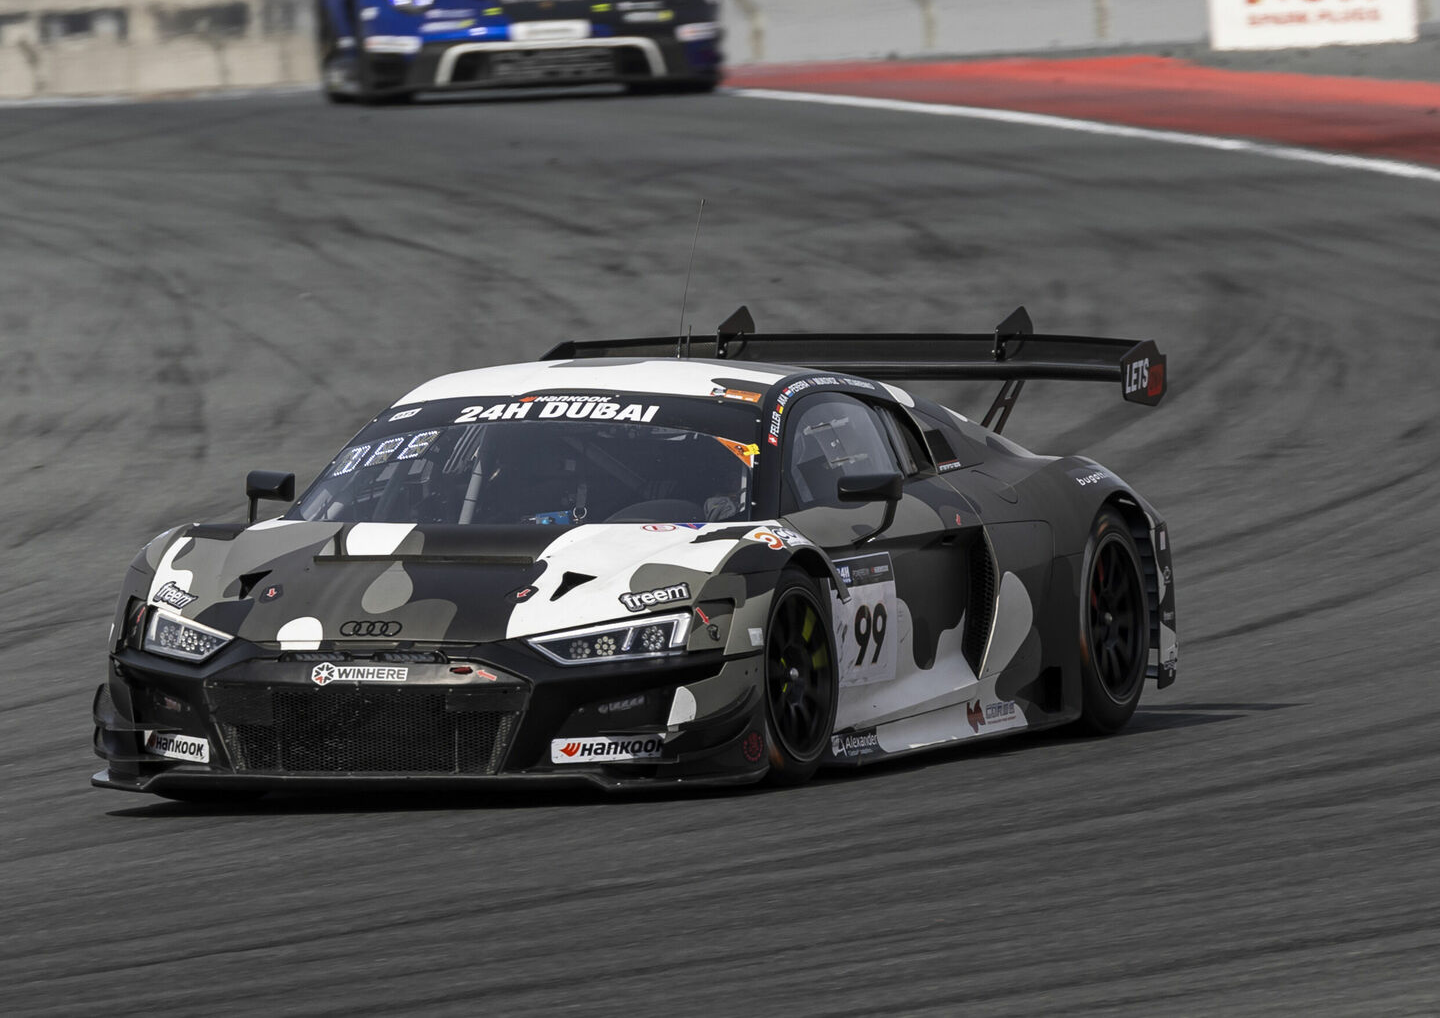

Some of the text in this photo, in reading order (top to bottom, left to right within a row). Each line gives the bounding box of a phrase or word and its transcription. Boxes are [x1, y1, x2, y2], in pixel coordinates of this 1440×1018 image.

[1125, 358, 1149, 394] LETS
[454, 401, 660, 423] 24H DUBAI
[157, 583, 194, 608] freem
[623, 585, 689, 610] freem
[854, 603, 888, 666] 99
[337, 667, 407, 680] WINHERE
